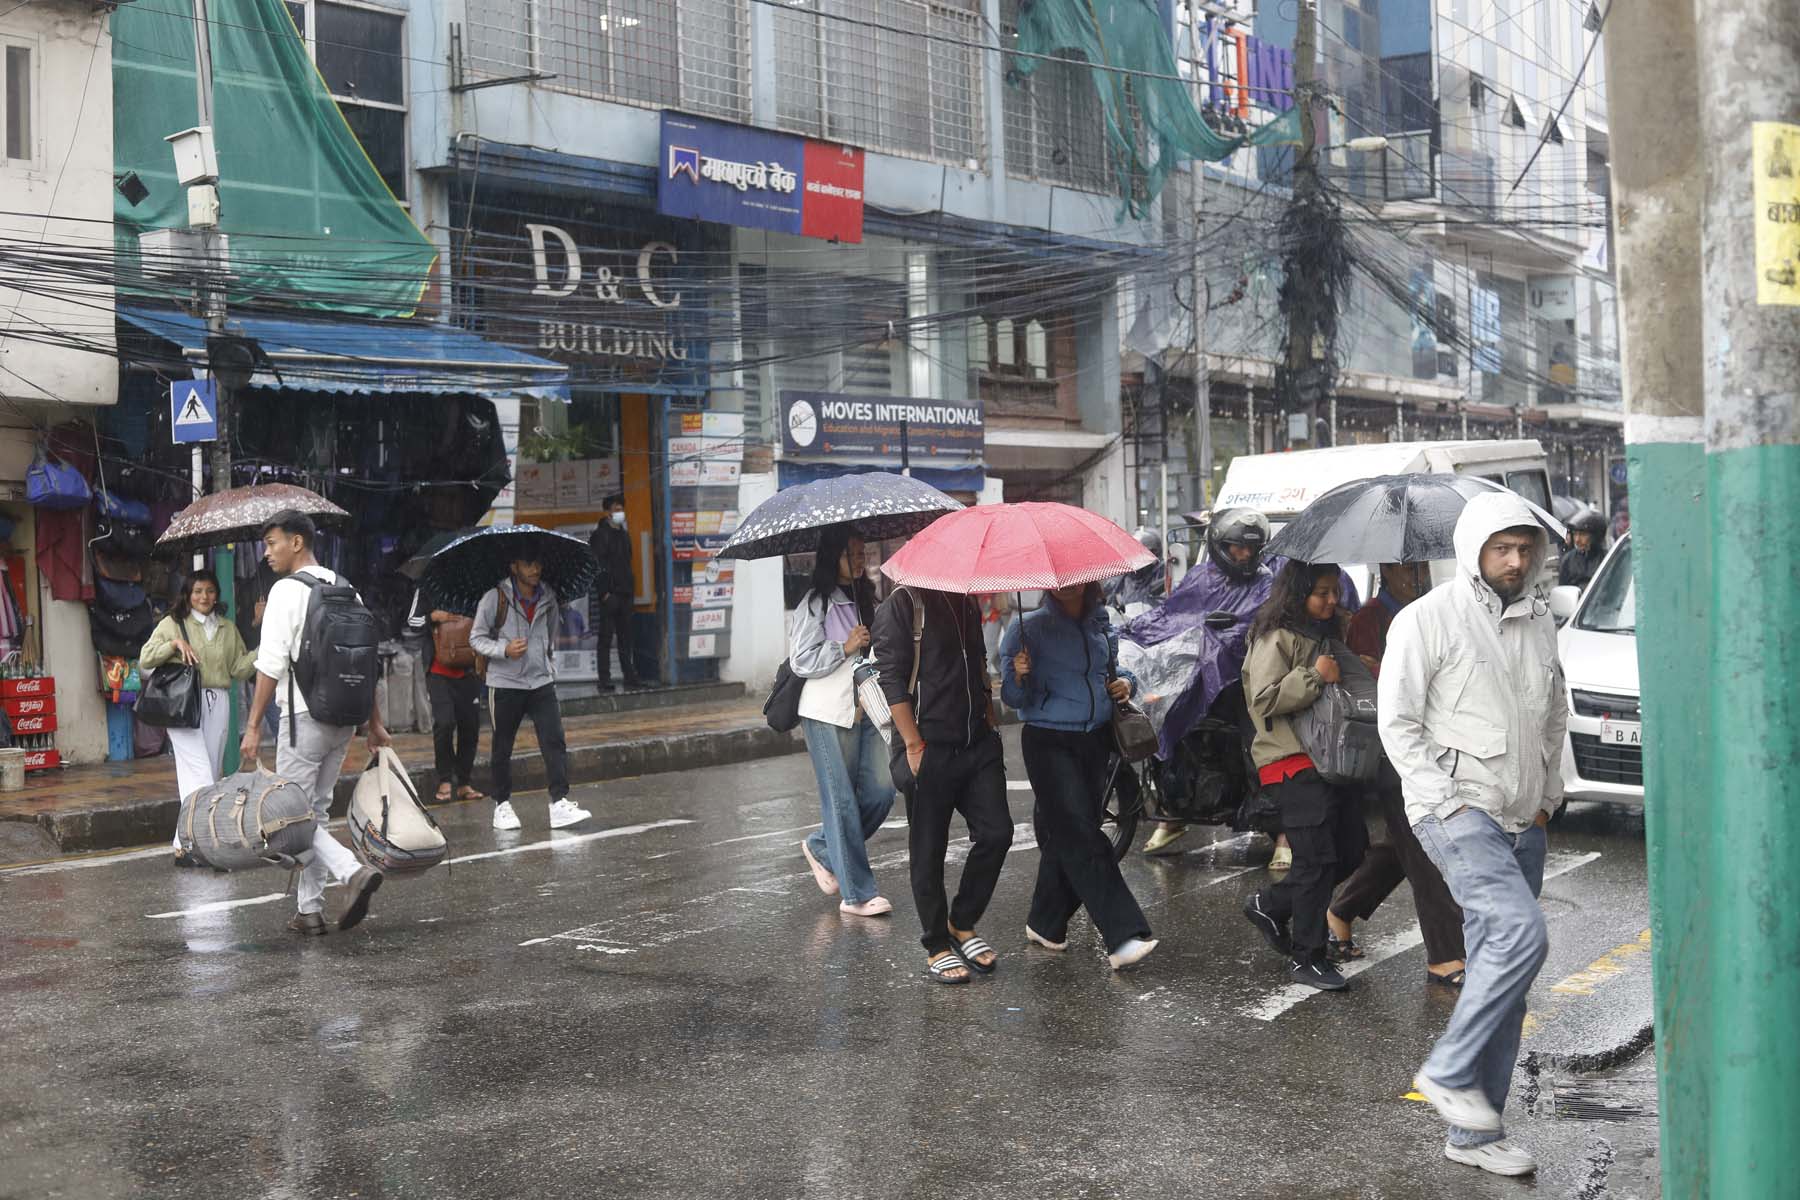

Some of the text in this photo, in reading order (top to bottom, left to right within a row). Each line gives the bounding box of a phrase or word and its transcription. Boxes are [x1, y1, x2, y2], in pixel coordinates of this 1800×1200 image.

[767, 162, 797, 193] बैंक
[525, 223, 681, 308] D & C
[538, 320, 688, 360] BUILDING
[821, 400, 983, 425] MOVES INTERNATIONAL
[696, 611, 721, 624] JAPAN
[1616, 730, 1642, 744] B A
